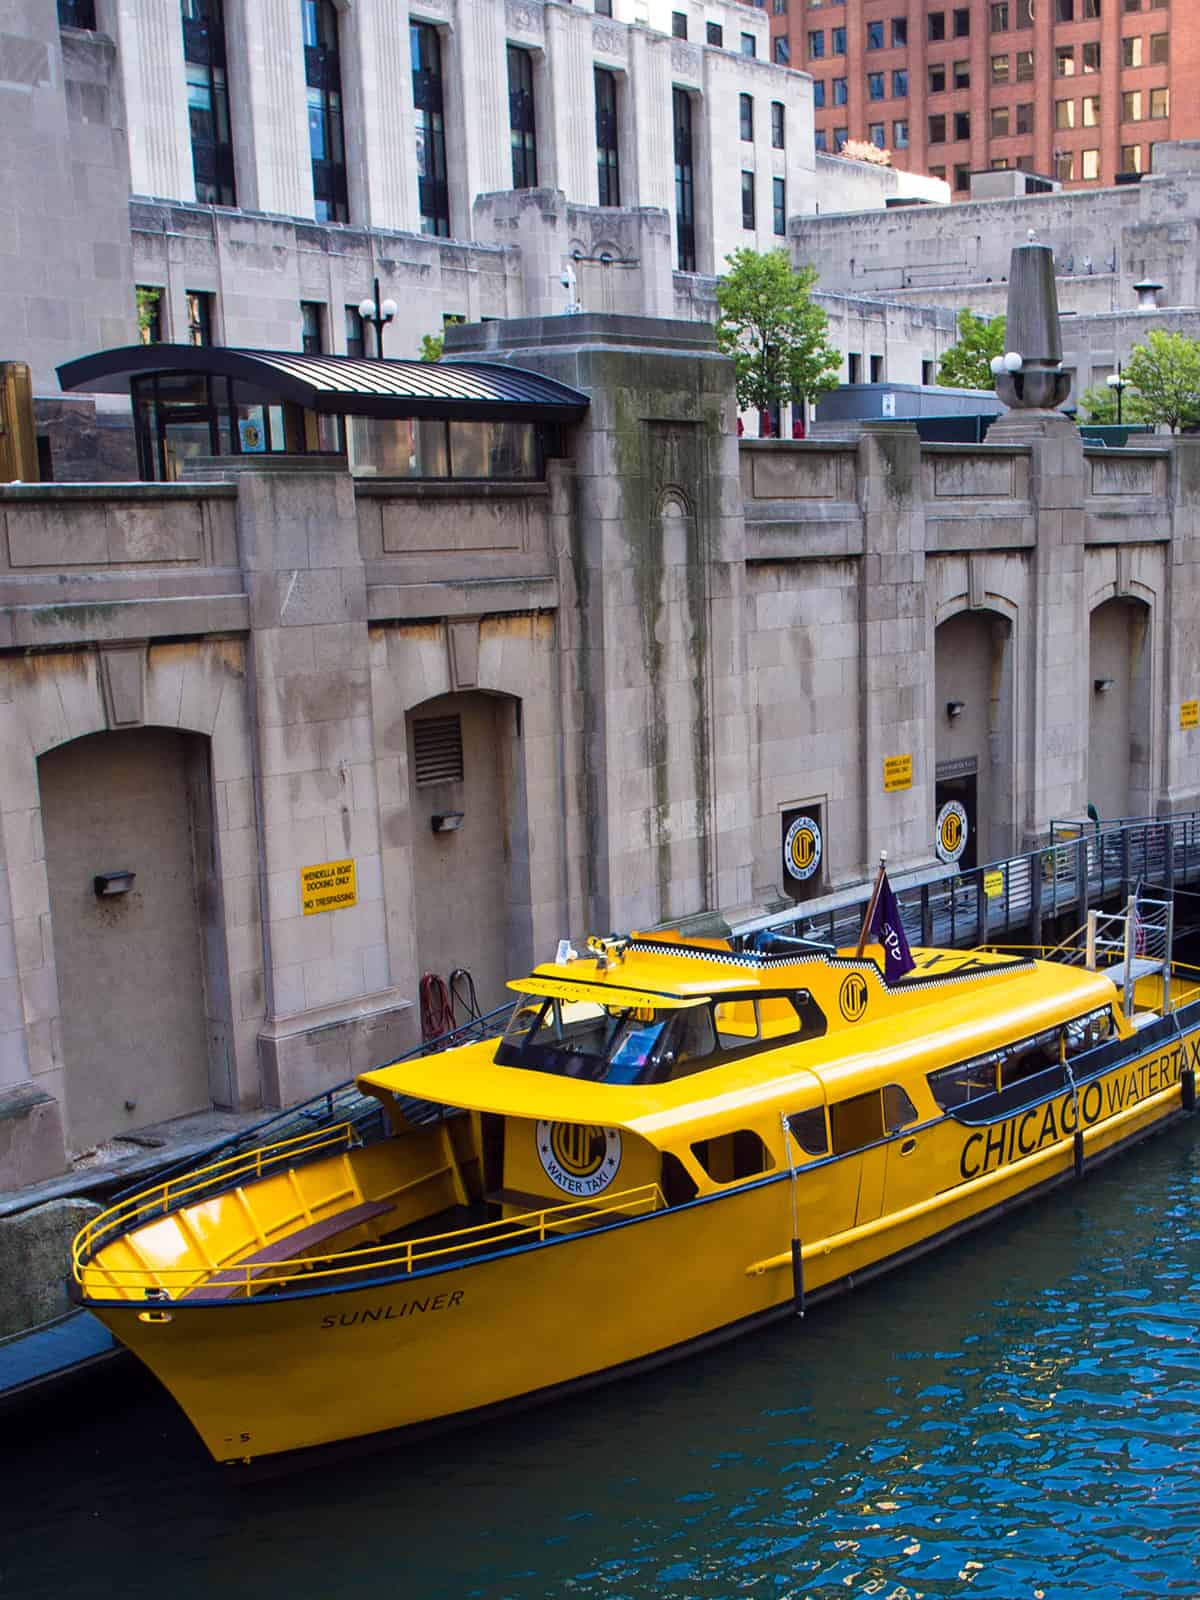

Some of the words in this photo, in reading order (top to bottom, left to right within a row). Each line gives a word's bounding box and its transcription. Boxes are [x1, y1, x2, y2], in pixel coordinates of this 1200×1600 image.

[336, 864, 352, 875] BOAT
[306, 879, 334, 891] DOCKING
[335, 876, 350, 886] ONLY
[304, 899, 313, 909] NO
[315, 891, 354, 906] TRESPASSING
[960, 1081, 1102, 1179] CHICAGO
[548, 1161, 582, 1193] WATER
[585, 1170, 609, 1193] TAXI
[320, 1289, 465, 1329] SUNLINER
